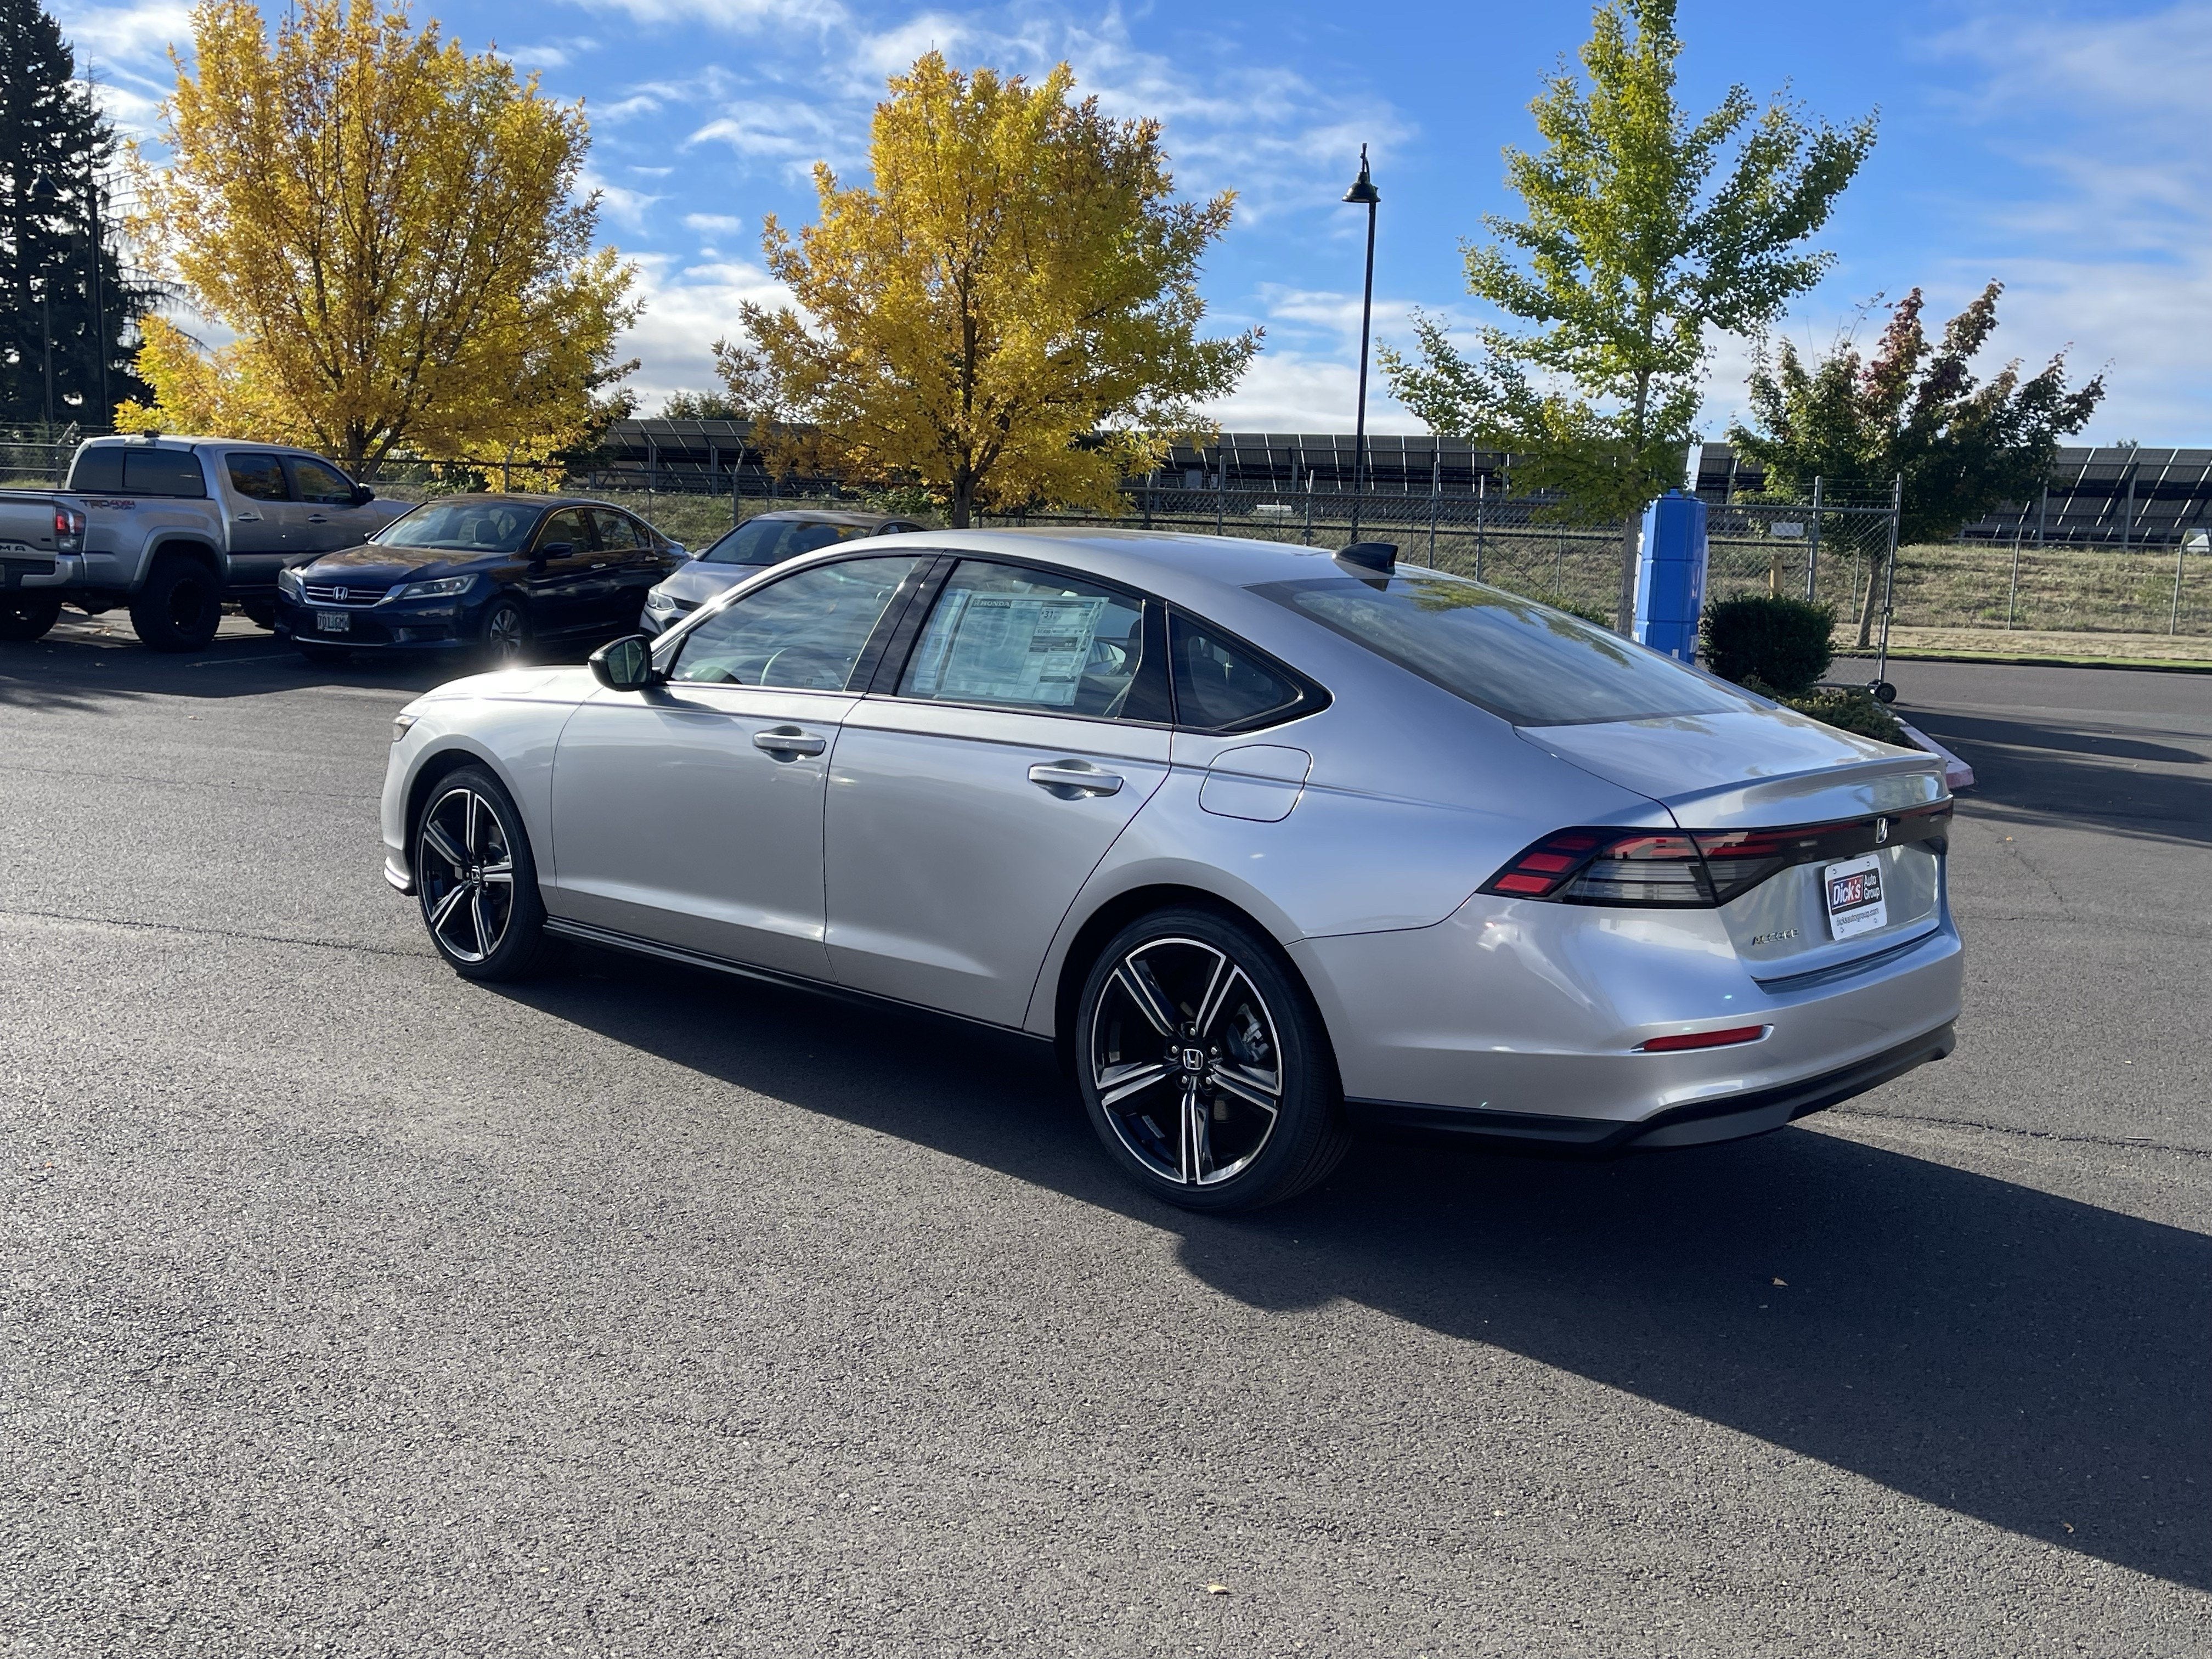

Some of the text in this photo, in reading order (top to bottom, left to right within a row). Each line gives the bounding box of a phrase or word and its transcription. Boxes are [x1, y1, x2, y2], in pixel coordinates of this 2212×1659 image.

[1864, 874, 1876, 887] Auto
[1833, 879, 1861, 905] Dick's
[1864, 887, 1881, 900] Group
[1751, 929, 1798, 946] ACCORD
